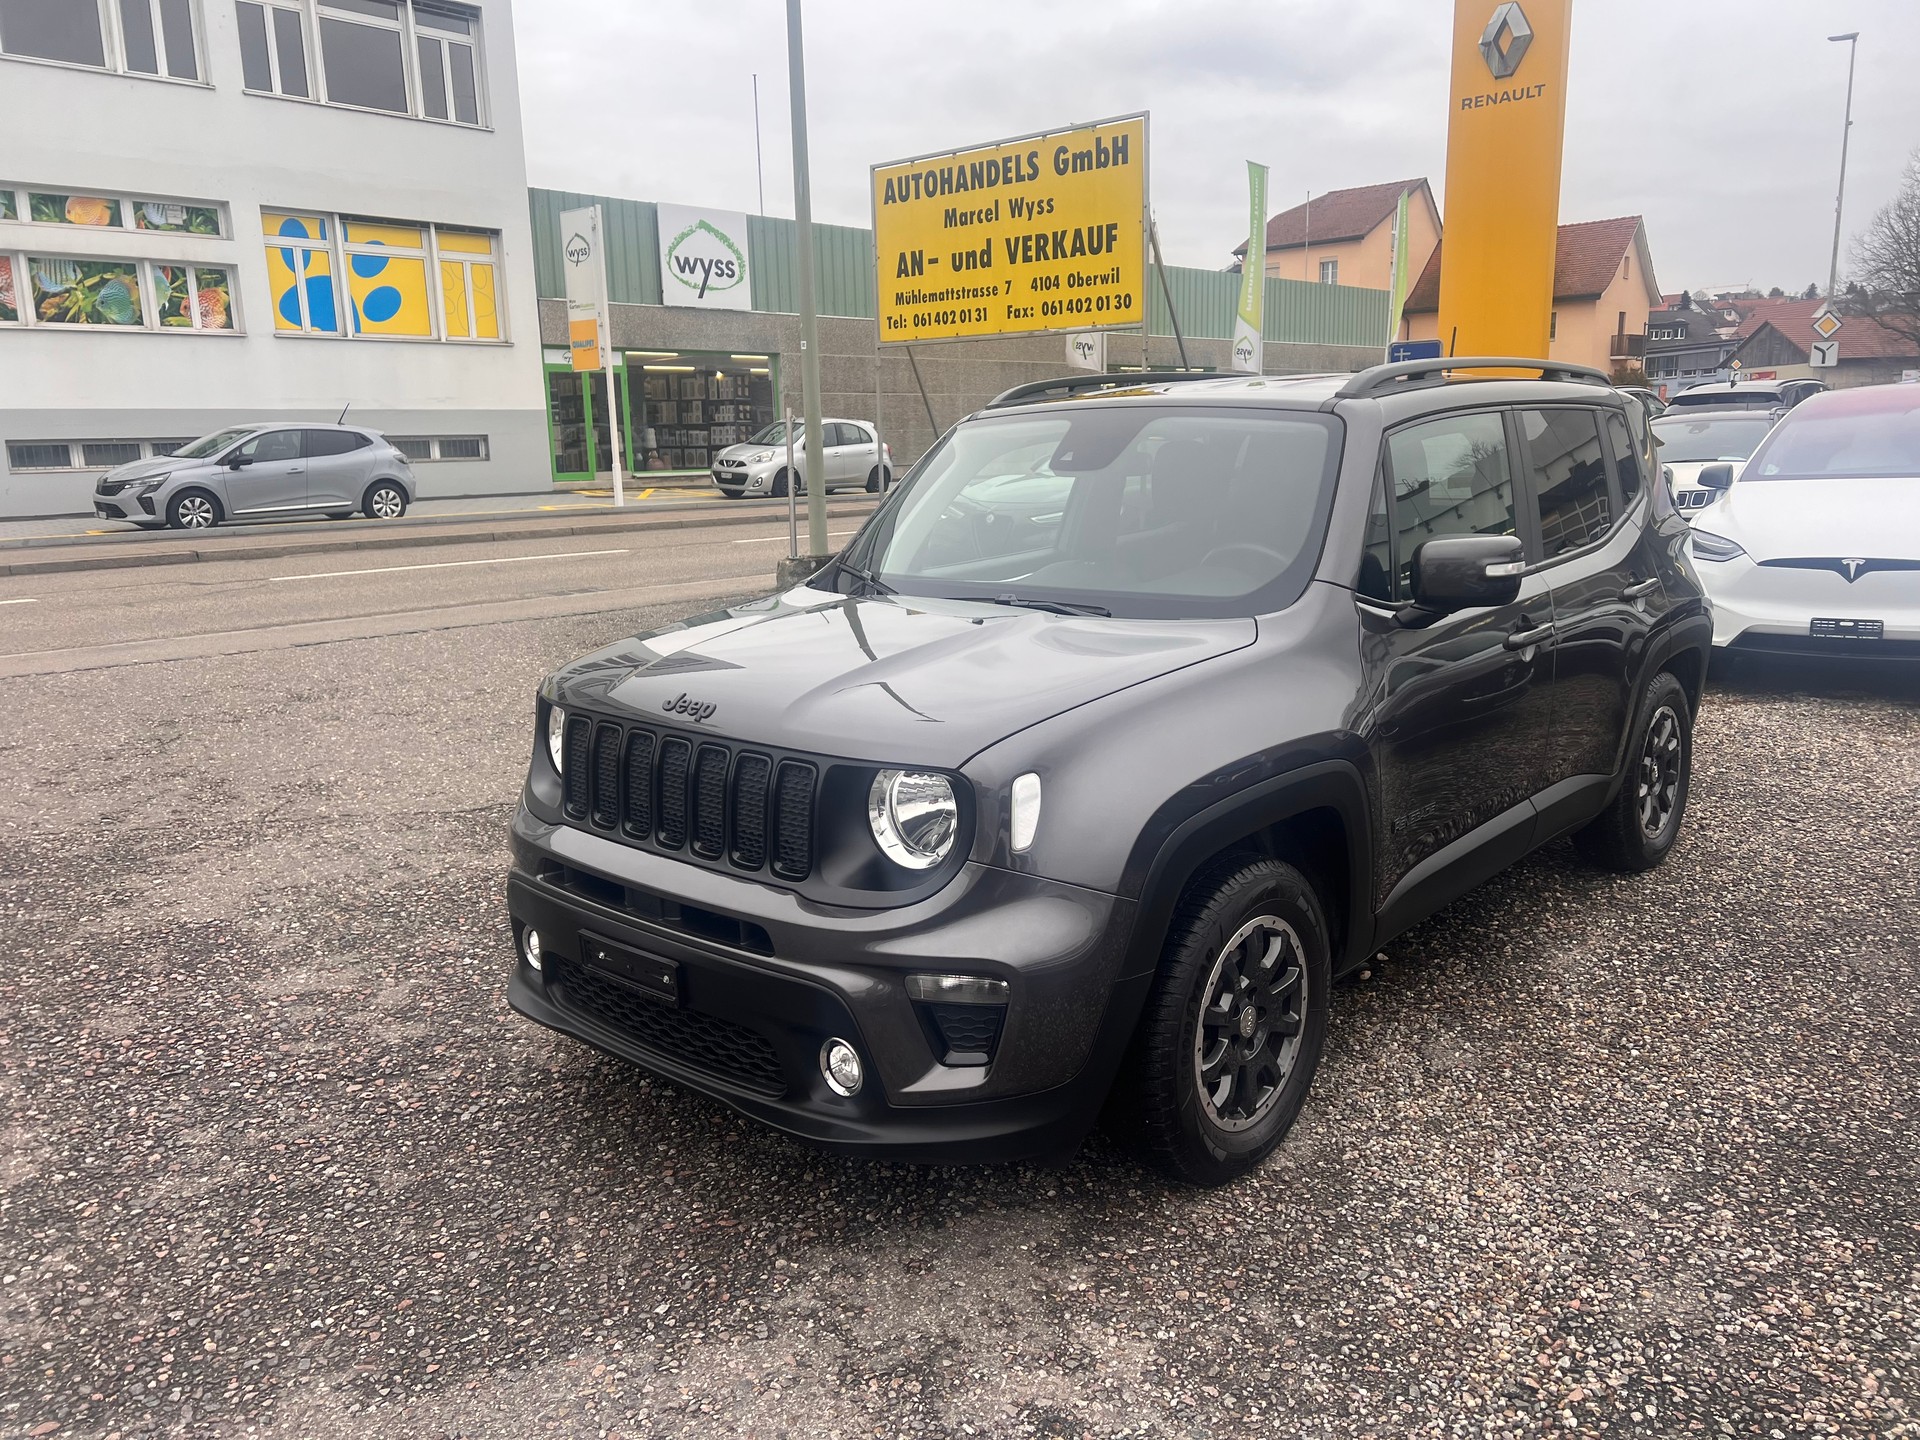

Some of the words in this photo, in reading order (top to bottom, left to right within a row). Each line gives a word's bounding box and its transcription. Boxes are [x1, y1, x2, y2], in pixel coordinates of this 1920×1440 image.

[1461, 83, 1546, 111] RENAULT
[883, 150, 1040, 205] AUTOHANDELS
[1053, 133, 1129, 176] GmbH
[944, 199, 999, 229] Marcel
[1008, 196, 1055, 221] Wyss
[568, 247, 588, 267] wyss
[951, 237, 992, 272] und
[1005, 222, 1118, 265] VERKAUF
[674, 255, 736, 299] wyss
[895, 285, 999, 306] Mühlemattstrasse
[1004, 279, 1012, 295] 7
[1031, 274, 1060, 292] 4104
[1067, 266, 1120, 289] Oberwil
[887, 313, 907, 330] Tel:
[1006, 304, 1034, 320] Fax:
[662, 692, 717, 722] Jeep
